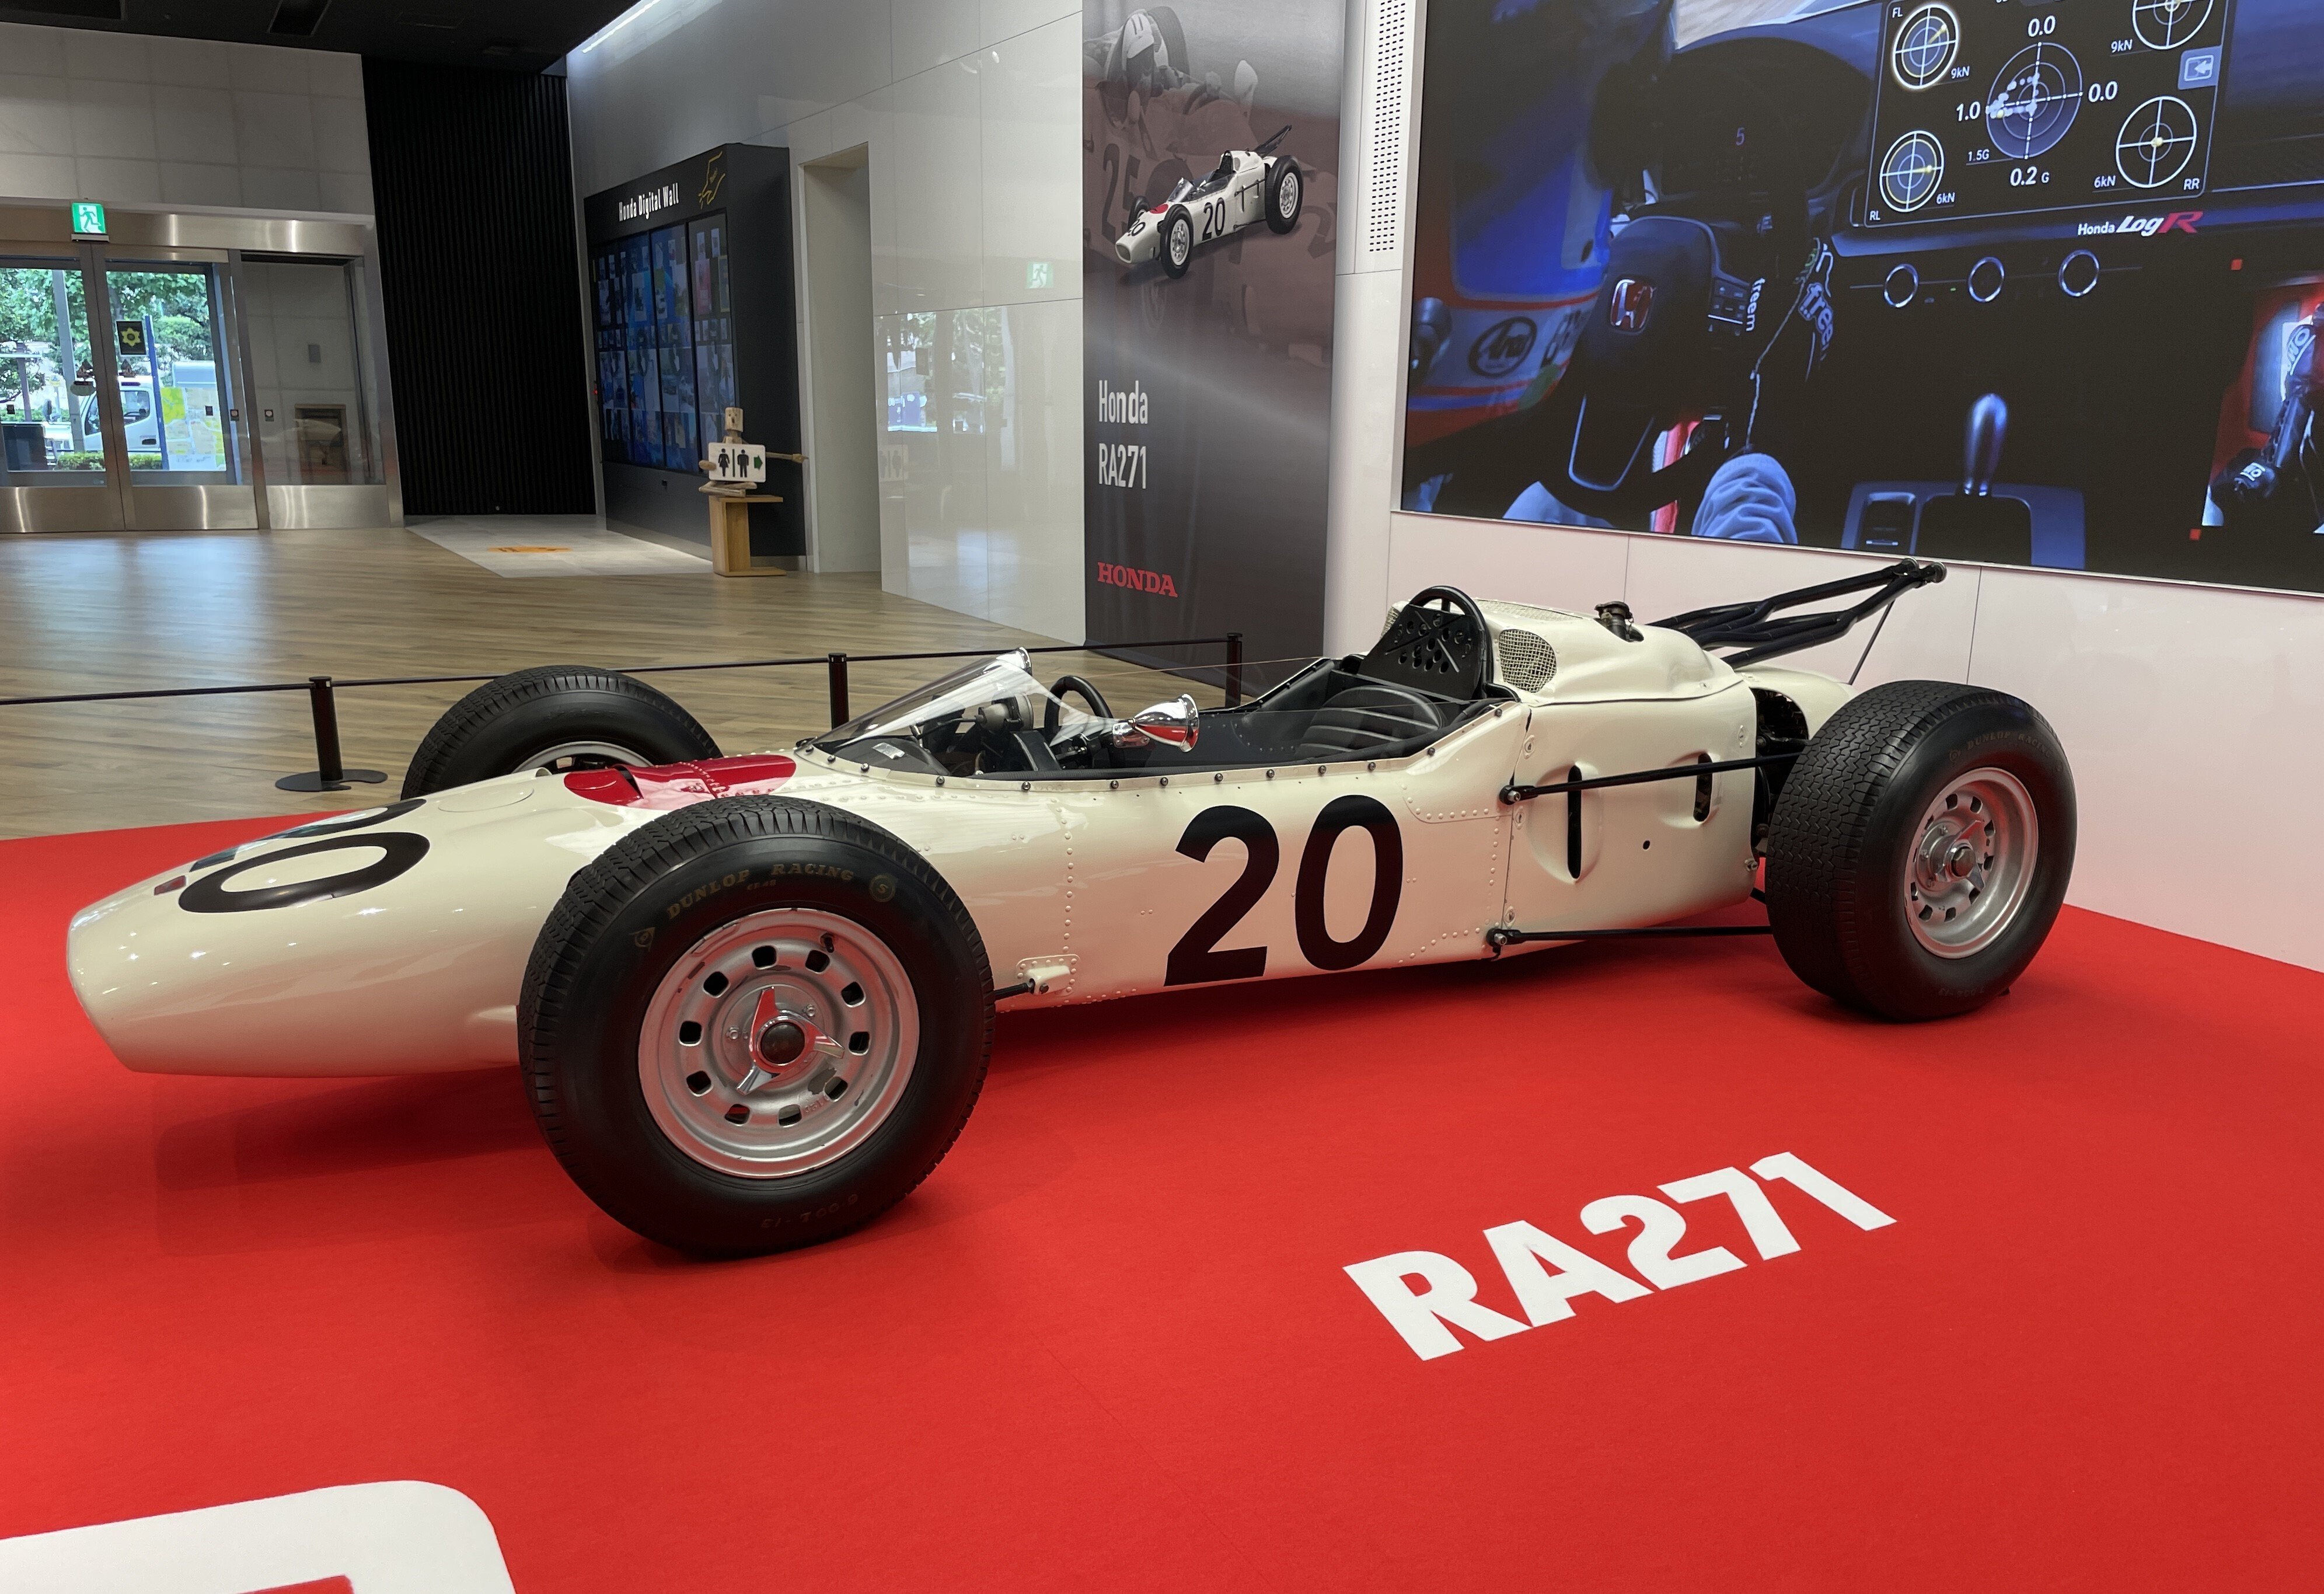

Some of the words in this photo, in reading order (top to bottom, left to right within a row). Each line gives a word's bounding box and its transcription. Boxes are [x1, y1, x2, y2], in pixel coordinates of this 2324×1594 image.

[1892, 7, 1903, 18] FL
[2028, 15, 2056, 37] 0.0
[2111, 39, 2133, 53] 9kN
[1950, 65, 1970, 79] 9kN
[2088, 81, 2118, 103] 0.0
[1956, 101, 1981, 121] 1.0
[1967, 149, 1990, 162] 1.5G
[2009, 166, 2037, 186] 0.2
[2041, 172, 2050, 183] G
[2094, 175, 2116, 189] 6kN
[2183, 177, 2200, 191] RR
[619, 197, 637, 222] Honda
[638, 188, 661, 220] Digital
[662, 182, 679, 208] Wall
[1936, 192, 1956, 204] 6kN
[1202, 197, 1226, 242] 20
[1869, 210, 1880, 221] RL
[2077, 221, 2116, 236] Honda
[1098, 380, 1149, 424] Honda
[1098, 442, 1147, 489] RA271
[1097, 561, 1178, 598] HONDA
[666, 869, 751, 920] DUNLOP
[769, 863, 854, 882] RACING
[1164, 794, 1403, 986] 20
[1343, 1152, 1898, 1362] RA271
